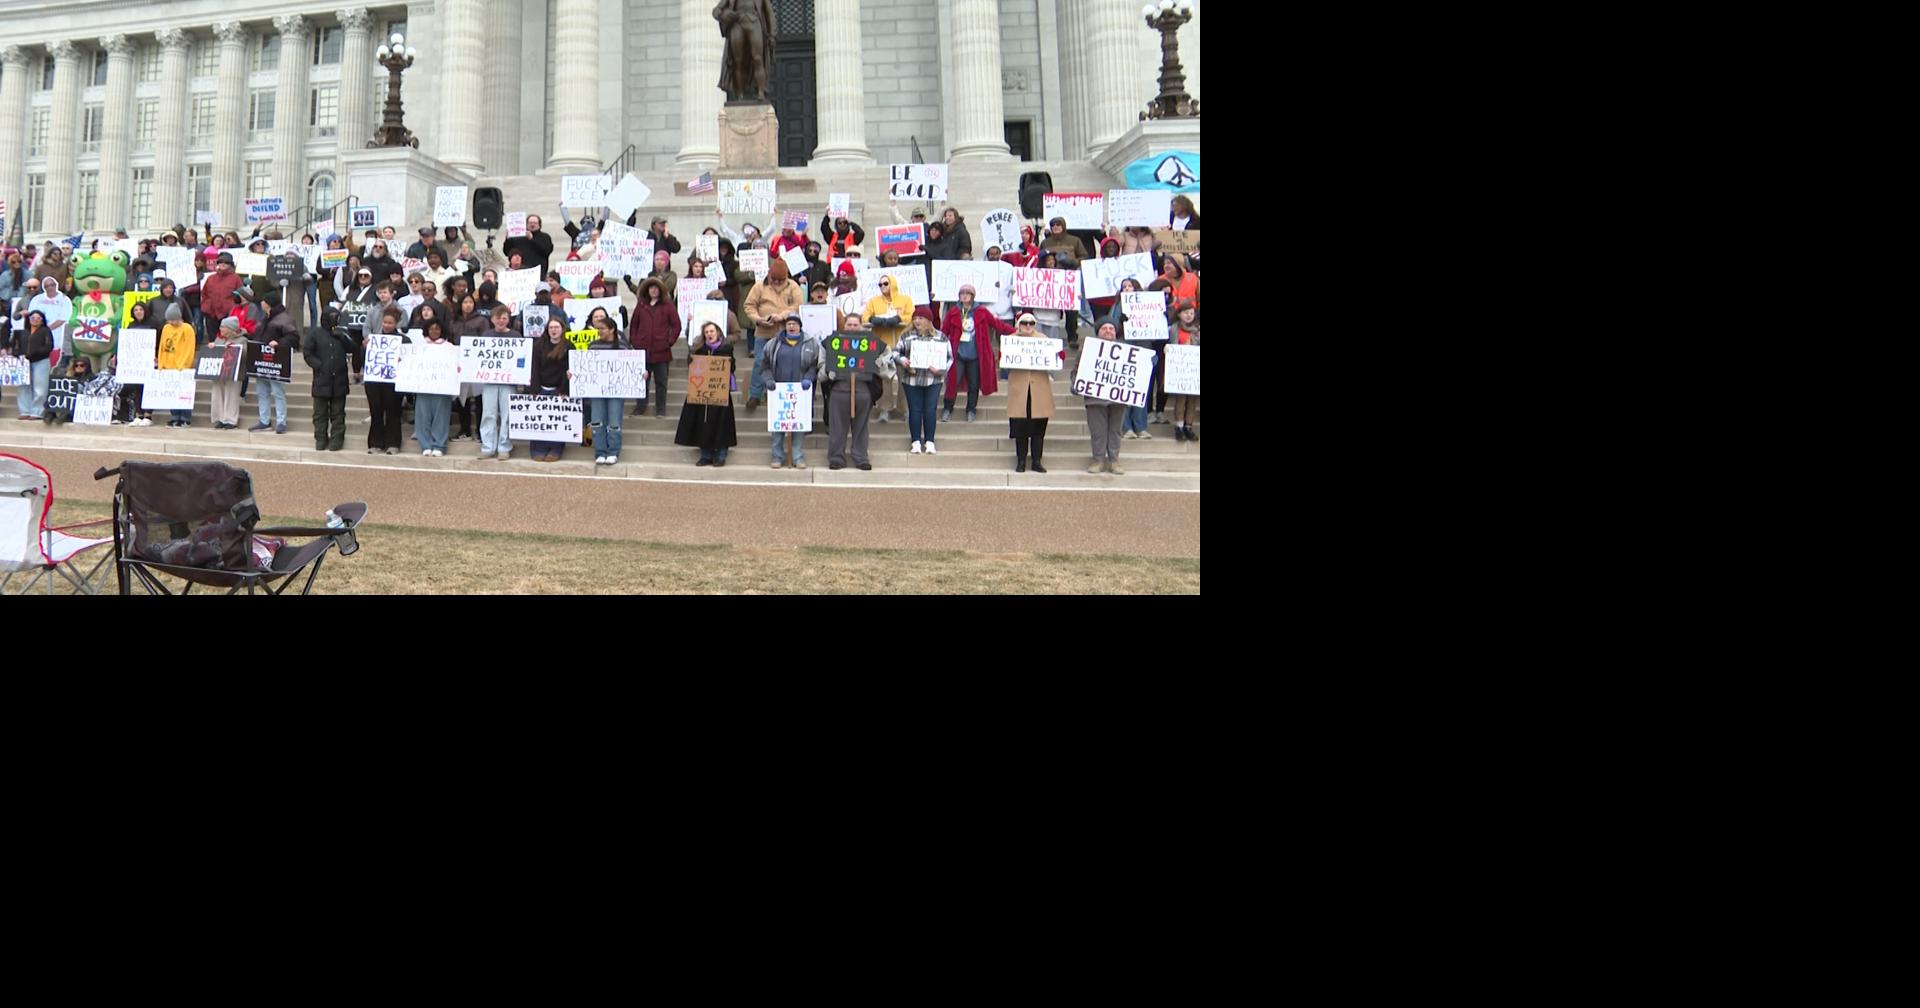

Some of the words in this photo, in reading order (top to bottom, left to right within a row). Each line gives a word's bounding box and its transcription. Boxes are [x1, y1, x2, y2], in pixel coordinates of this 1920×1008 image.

[892, 165, 915, 180] BE
[567, 178, 603, 191] FUCK
[892, 183, 942, 199] GOOD
[986, 211, 1013, 225] RENEE
[558, 265, 601, 275] ABOLISH
[1059, 284, 1075, 303] ON
[1125, 293, 1141, 303] ICE
[370, 336, 398, 350] ABC
[472, 338, 487, 349] OH
[491, 338, 526, 348] SORRY
[832, 338, 877, 351] CRUSH
[262, 344, 275, 354] ICE
[463, 349, 470, 358] I
[477, 350, 515, 360] ASKED
[1098, 341, 1140, 364] ICE
[573, 351, 600, 360] STOP
[1005, 355, 1022, 365] NO
[254, 361, 282, 369] AMERICAN
[480, 360, 502, 369] FOR
[573, 360, 643, 375] PRETENDING
[837, 355, 865, 369] ICE
[1095, 359, 1137, 376] KILLER
[475, 371, 490, 381] NO
[494, 372, 512, 383] ICE
[573, 374, 599, 385] YOUR
[608, 374, 645, 386] RACISM
[1095, 371, 1136, 389] THUGS
[49, 379, 78, 394] ICE
[575, 386, 587, 396] IS
[786, 383, 794, 393] I
[1075, 378, 1105, 397] GET
[1109, 387, 1146, 406] OUT!
[48, 396, 76, 410] OUT
[510, 394, 558, 403] IMMIGRANTS
[561, 397, 581, 405] ARE
[510, 403, 531, 412] NOT
[535, 403, 582, 413] CRIMINAL
[783, 401, 798, 410] MY
[524, 414, 543, 423] BUT
[547, 414, 568, 423] THE
[777, 410, 798, 420] ICE
[510, 423, 559, 431] PRESIDENT
